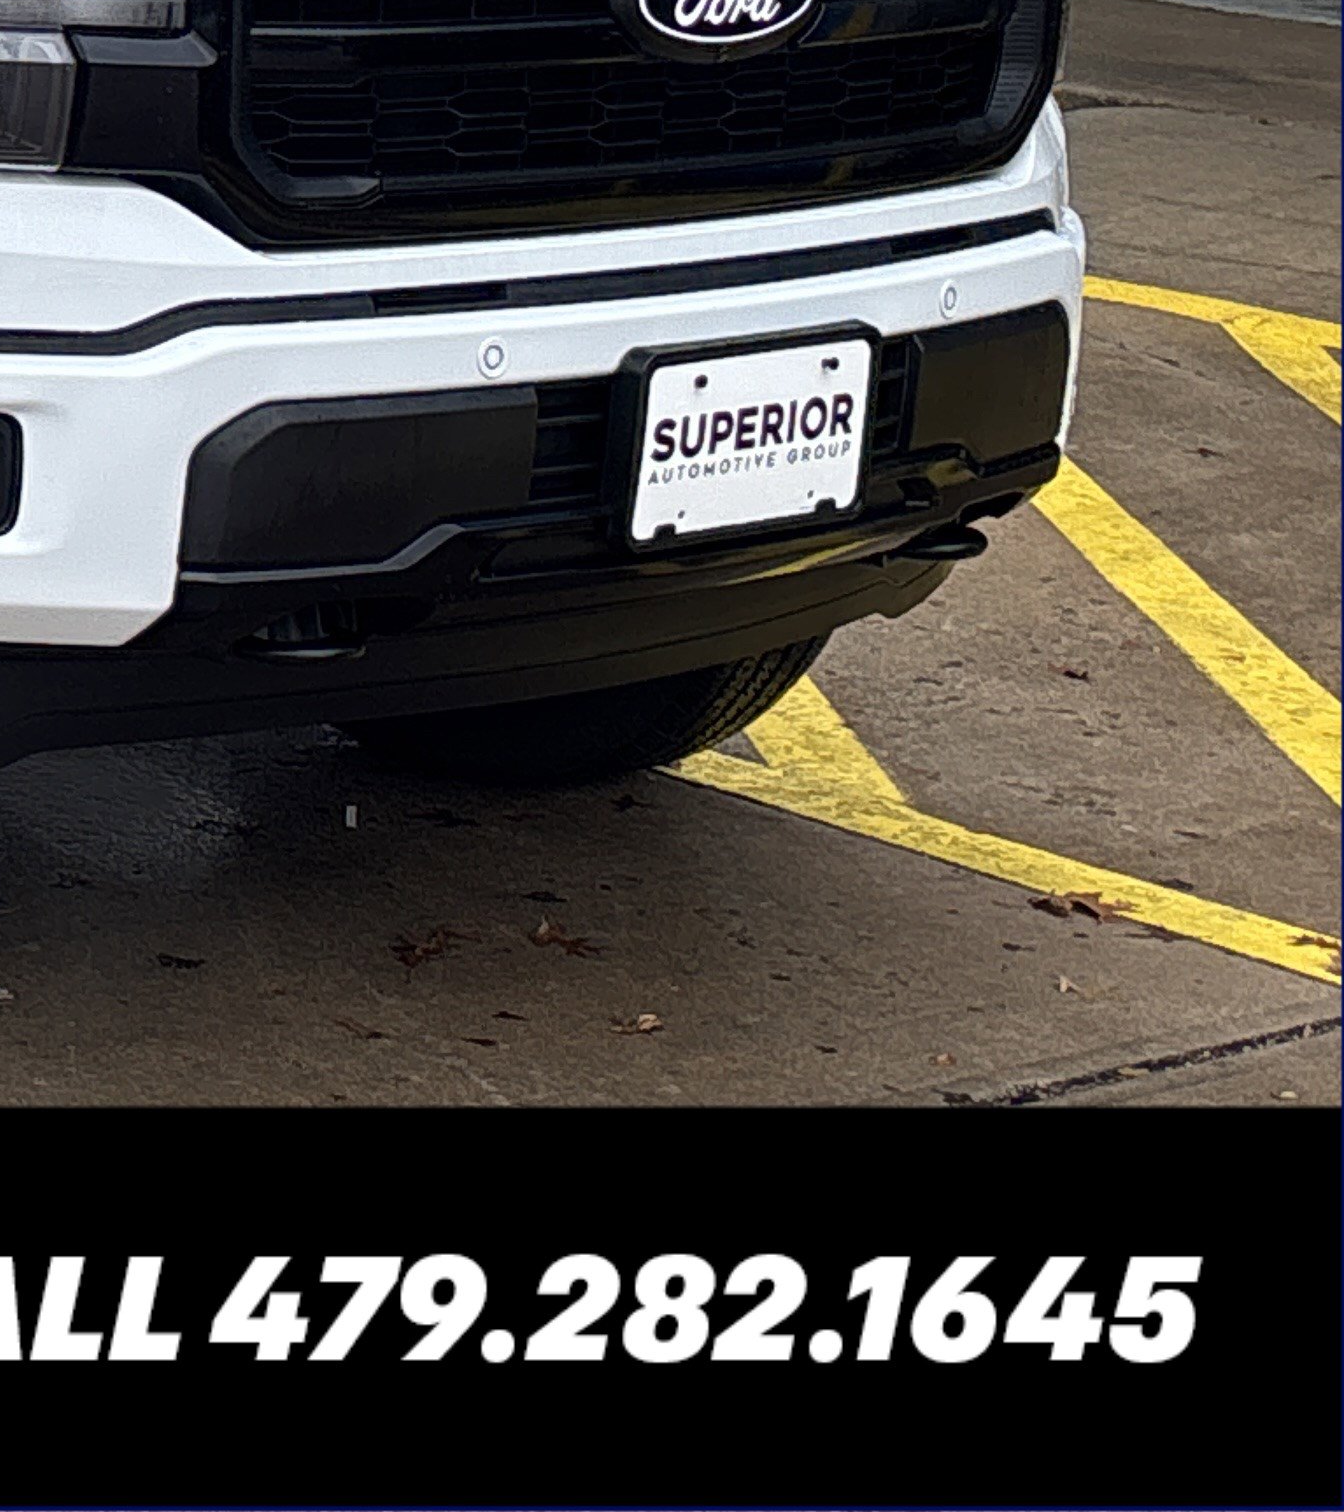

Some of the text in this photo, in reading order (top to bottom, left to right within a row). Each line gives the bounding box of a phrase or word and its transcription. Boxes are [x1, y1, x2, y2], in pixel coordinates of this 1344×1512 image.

[650, 393, 855, 462] SUPERIOR
[647, 440, 852, 486] AUTOMOTIVE GROUP
